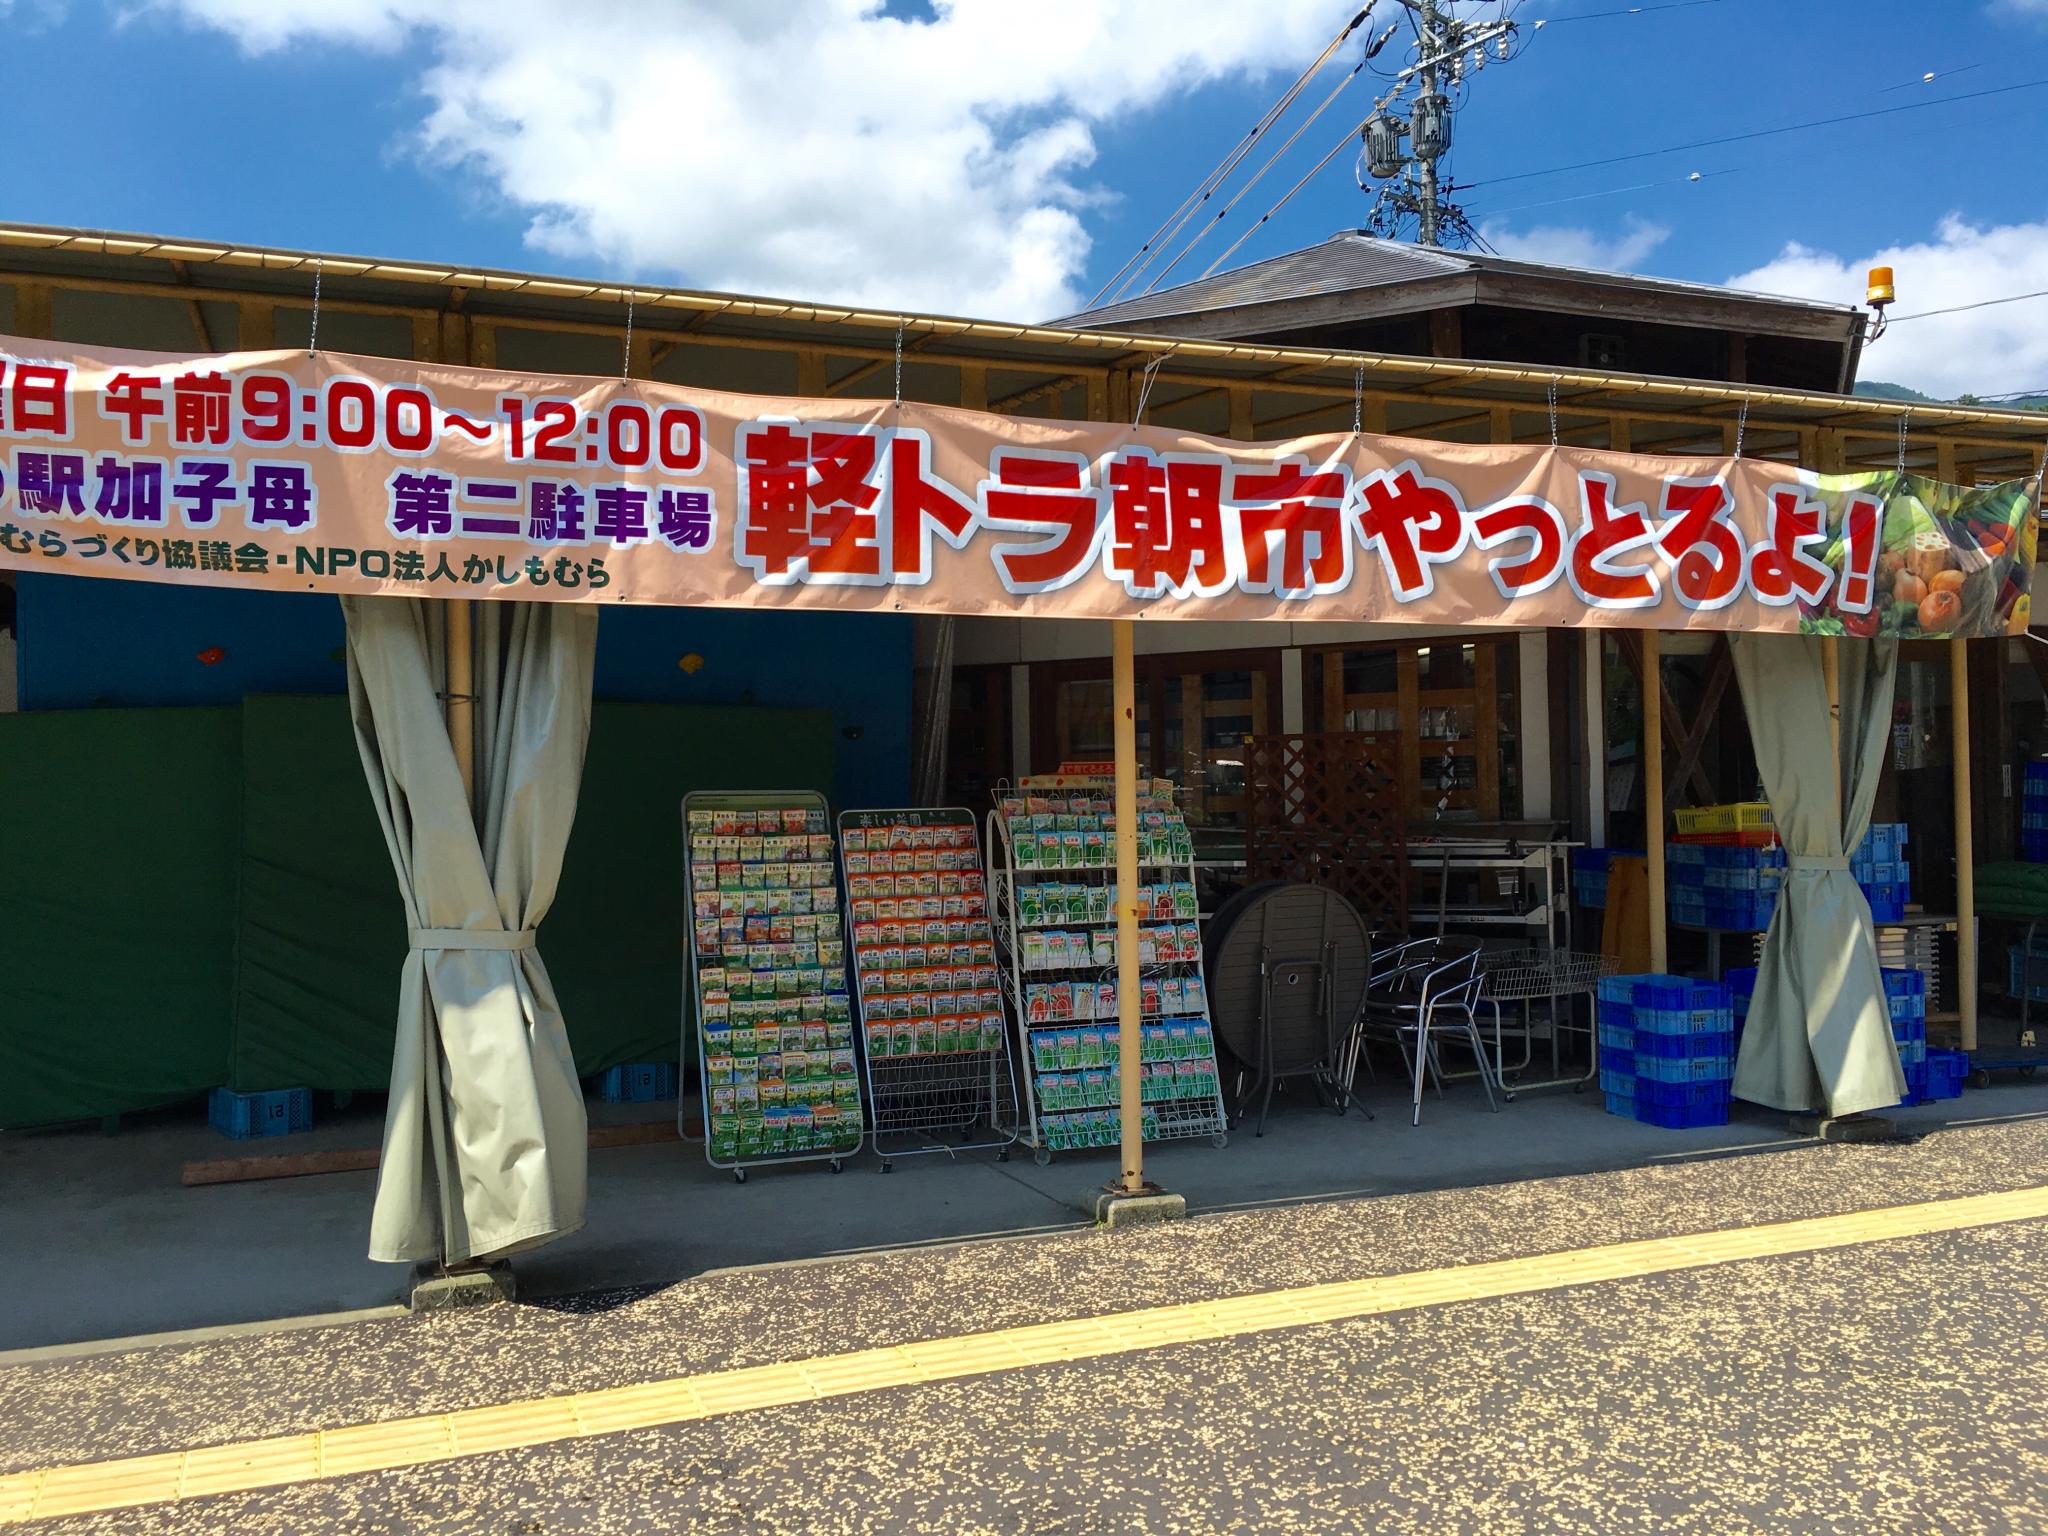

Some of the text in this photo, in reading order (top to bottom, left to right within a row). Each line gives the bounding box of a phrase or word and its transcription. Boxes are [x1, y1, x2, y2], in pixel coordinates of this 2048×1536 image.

[0, 361, 68, 435] 日
[0, 452, 711, 548] 駅加子母 第二駐車場
[745, 424, 1879, 606] 軽トラ朝市やっとるよ!
